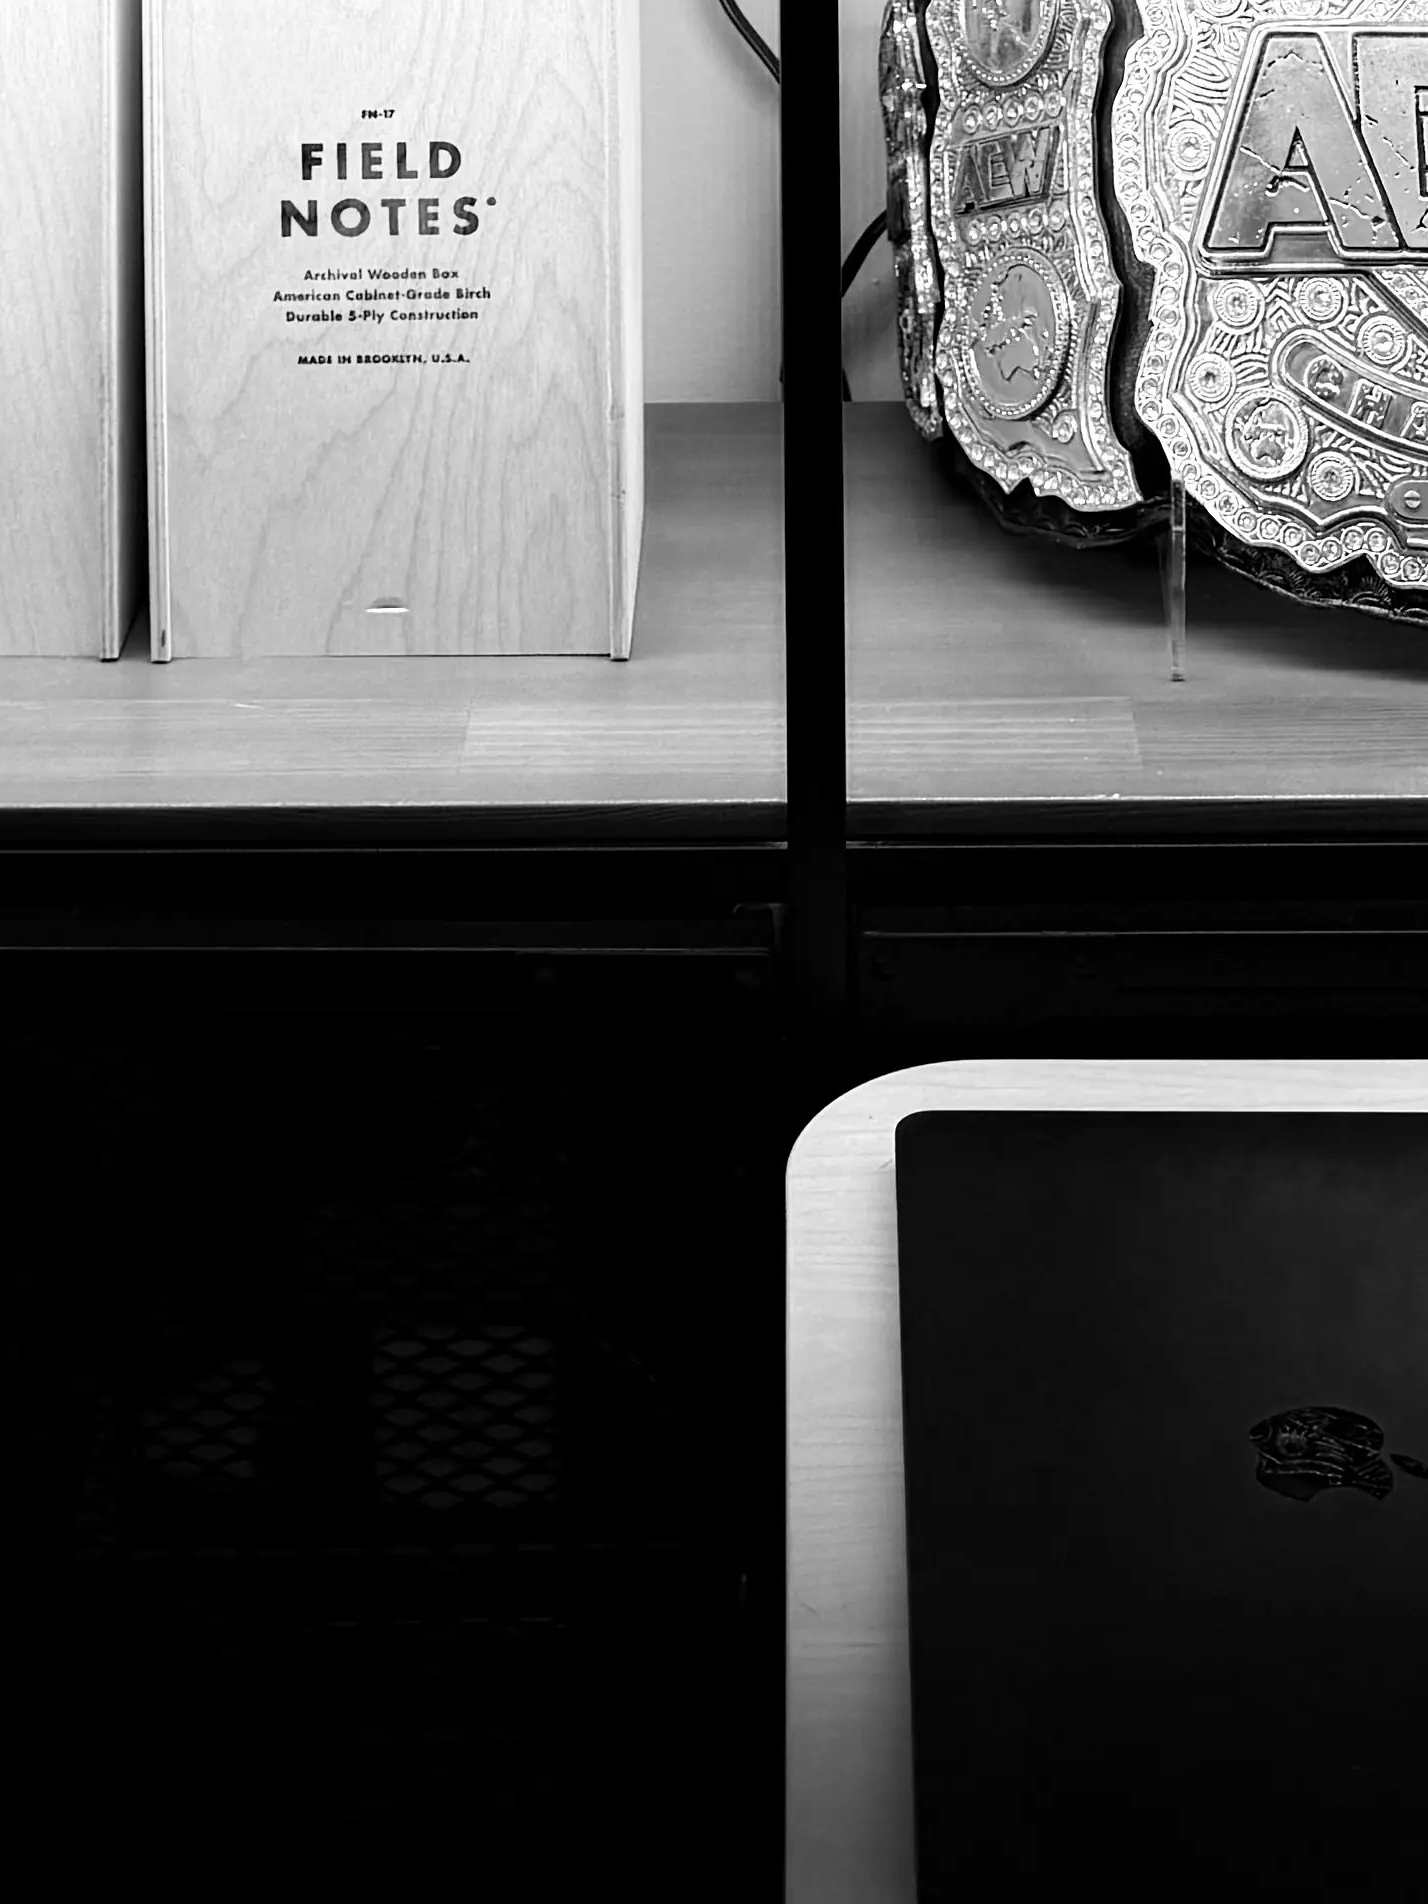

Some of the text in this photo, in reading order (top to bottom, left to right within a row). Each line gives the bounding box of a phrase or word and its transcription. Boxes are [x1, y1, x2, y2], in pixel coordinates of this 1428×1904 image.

[300, 141, 462, 180] FIELD
[952, 126, 1051, 214] AEW
[303, 268, 460, 282] Archival Wooden Box
[273, 287, 491, 303] American Cabinet-Grade Birch
[285, 309, 479, 325] Durable 5-Ply Construction
[297, 354, 470, 366] MADE IN BROOKLYN, U.S.A.
